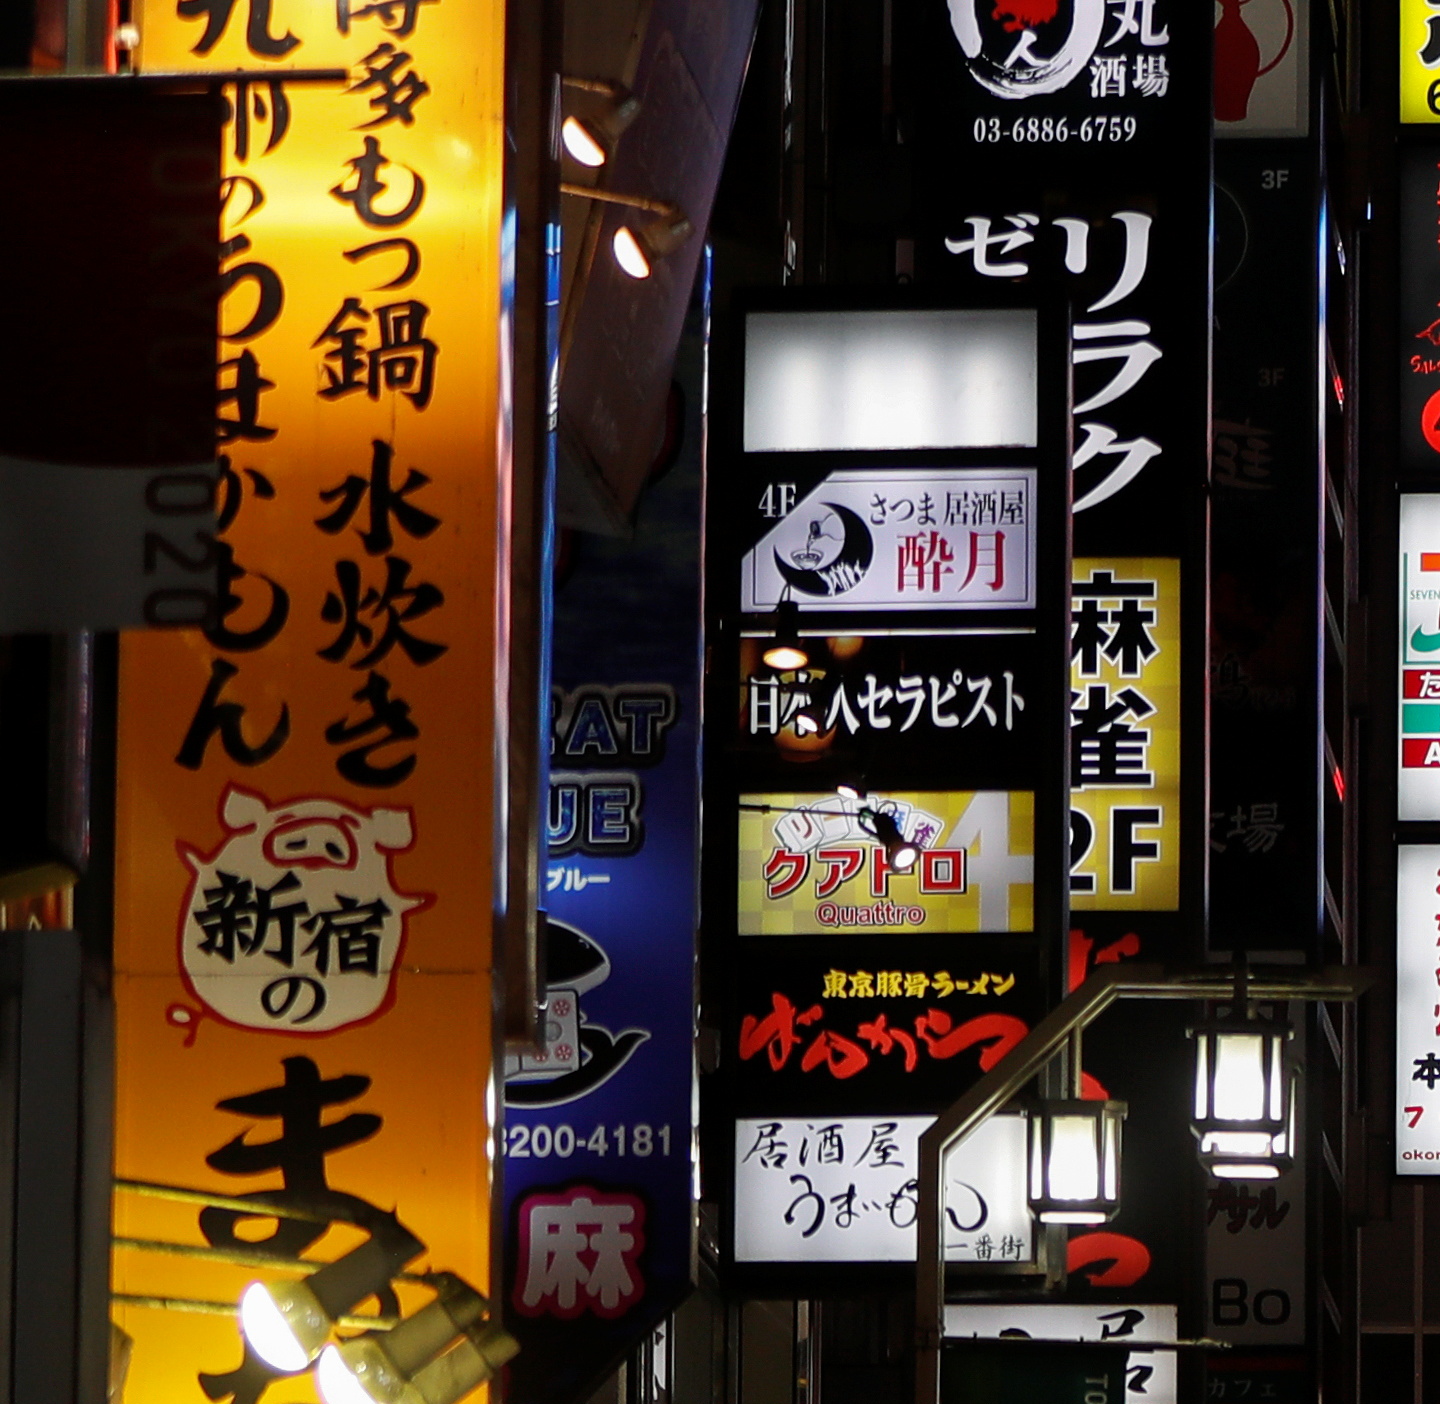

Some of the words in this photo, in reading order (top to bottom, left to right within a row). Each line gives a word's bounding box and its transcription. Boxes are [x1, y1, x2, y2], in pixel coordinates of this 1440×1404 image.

[1090, 53, 1170, 98] 酒場
[973, 116, 1137, 143] 03-6886-6759
[869, 491, 937, 527] さつま
[943, 490, 1025, 527] 居酒屋
[896, 529, 1006, 593] 酔月
[314, 438, 448, 790] 水炊き
[194, 866, 392, 977] 新宿
[816, 901, 925, 928] Quattro
[261, 974, 327, 1024] の
[821, 969, 1015, 999] 東京豚骨ラーメン
[741, 1121, 906, 1170] 居酒屋
[522, 1196, 636, 1314] 麻
